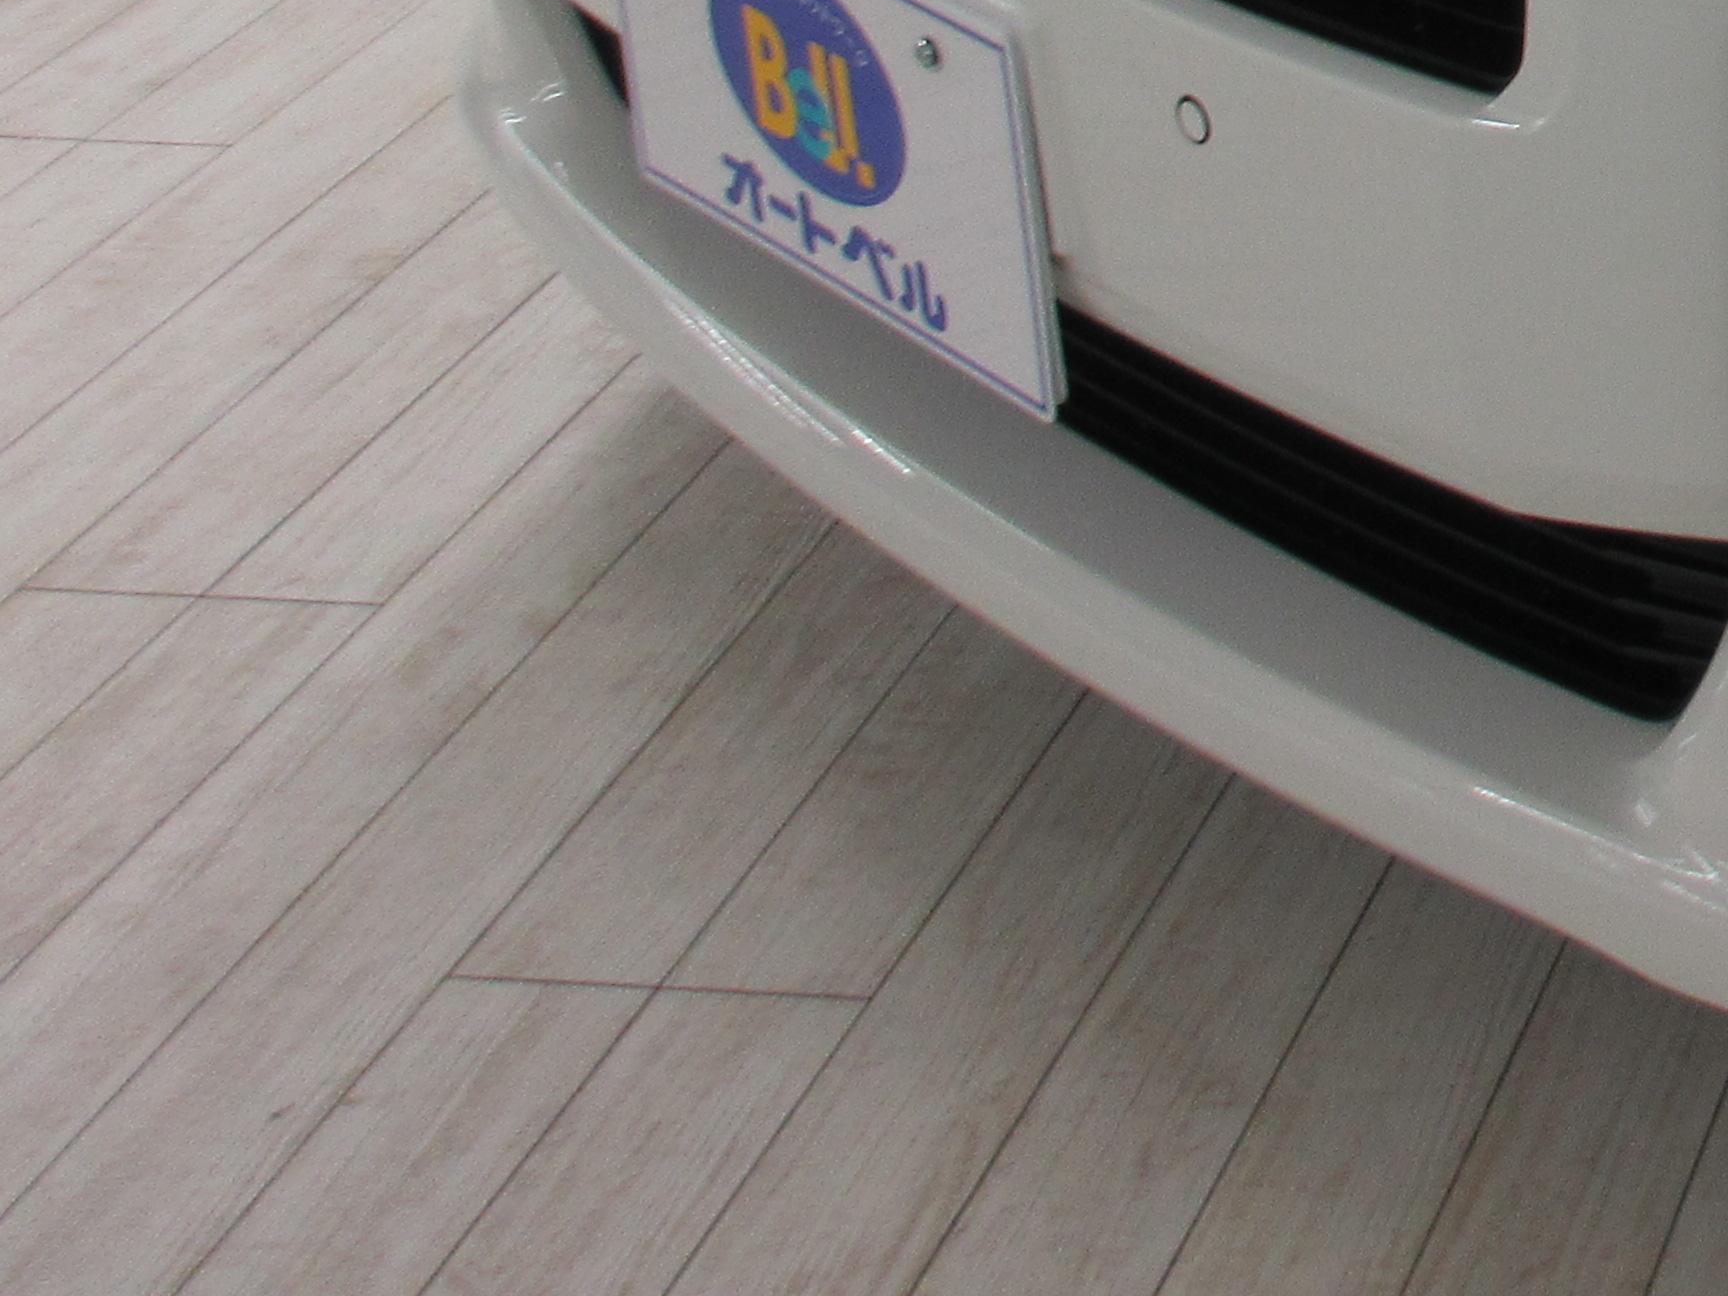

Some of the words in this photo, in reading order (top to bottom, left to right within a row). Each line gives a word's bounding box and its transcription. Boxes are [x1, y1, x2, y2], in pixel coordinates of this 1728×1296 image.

[721, 152, 947, 333] オートベル
